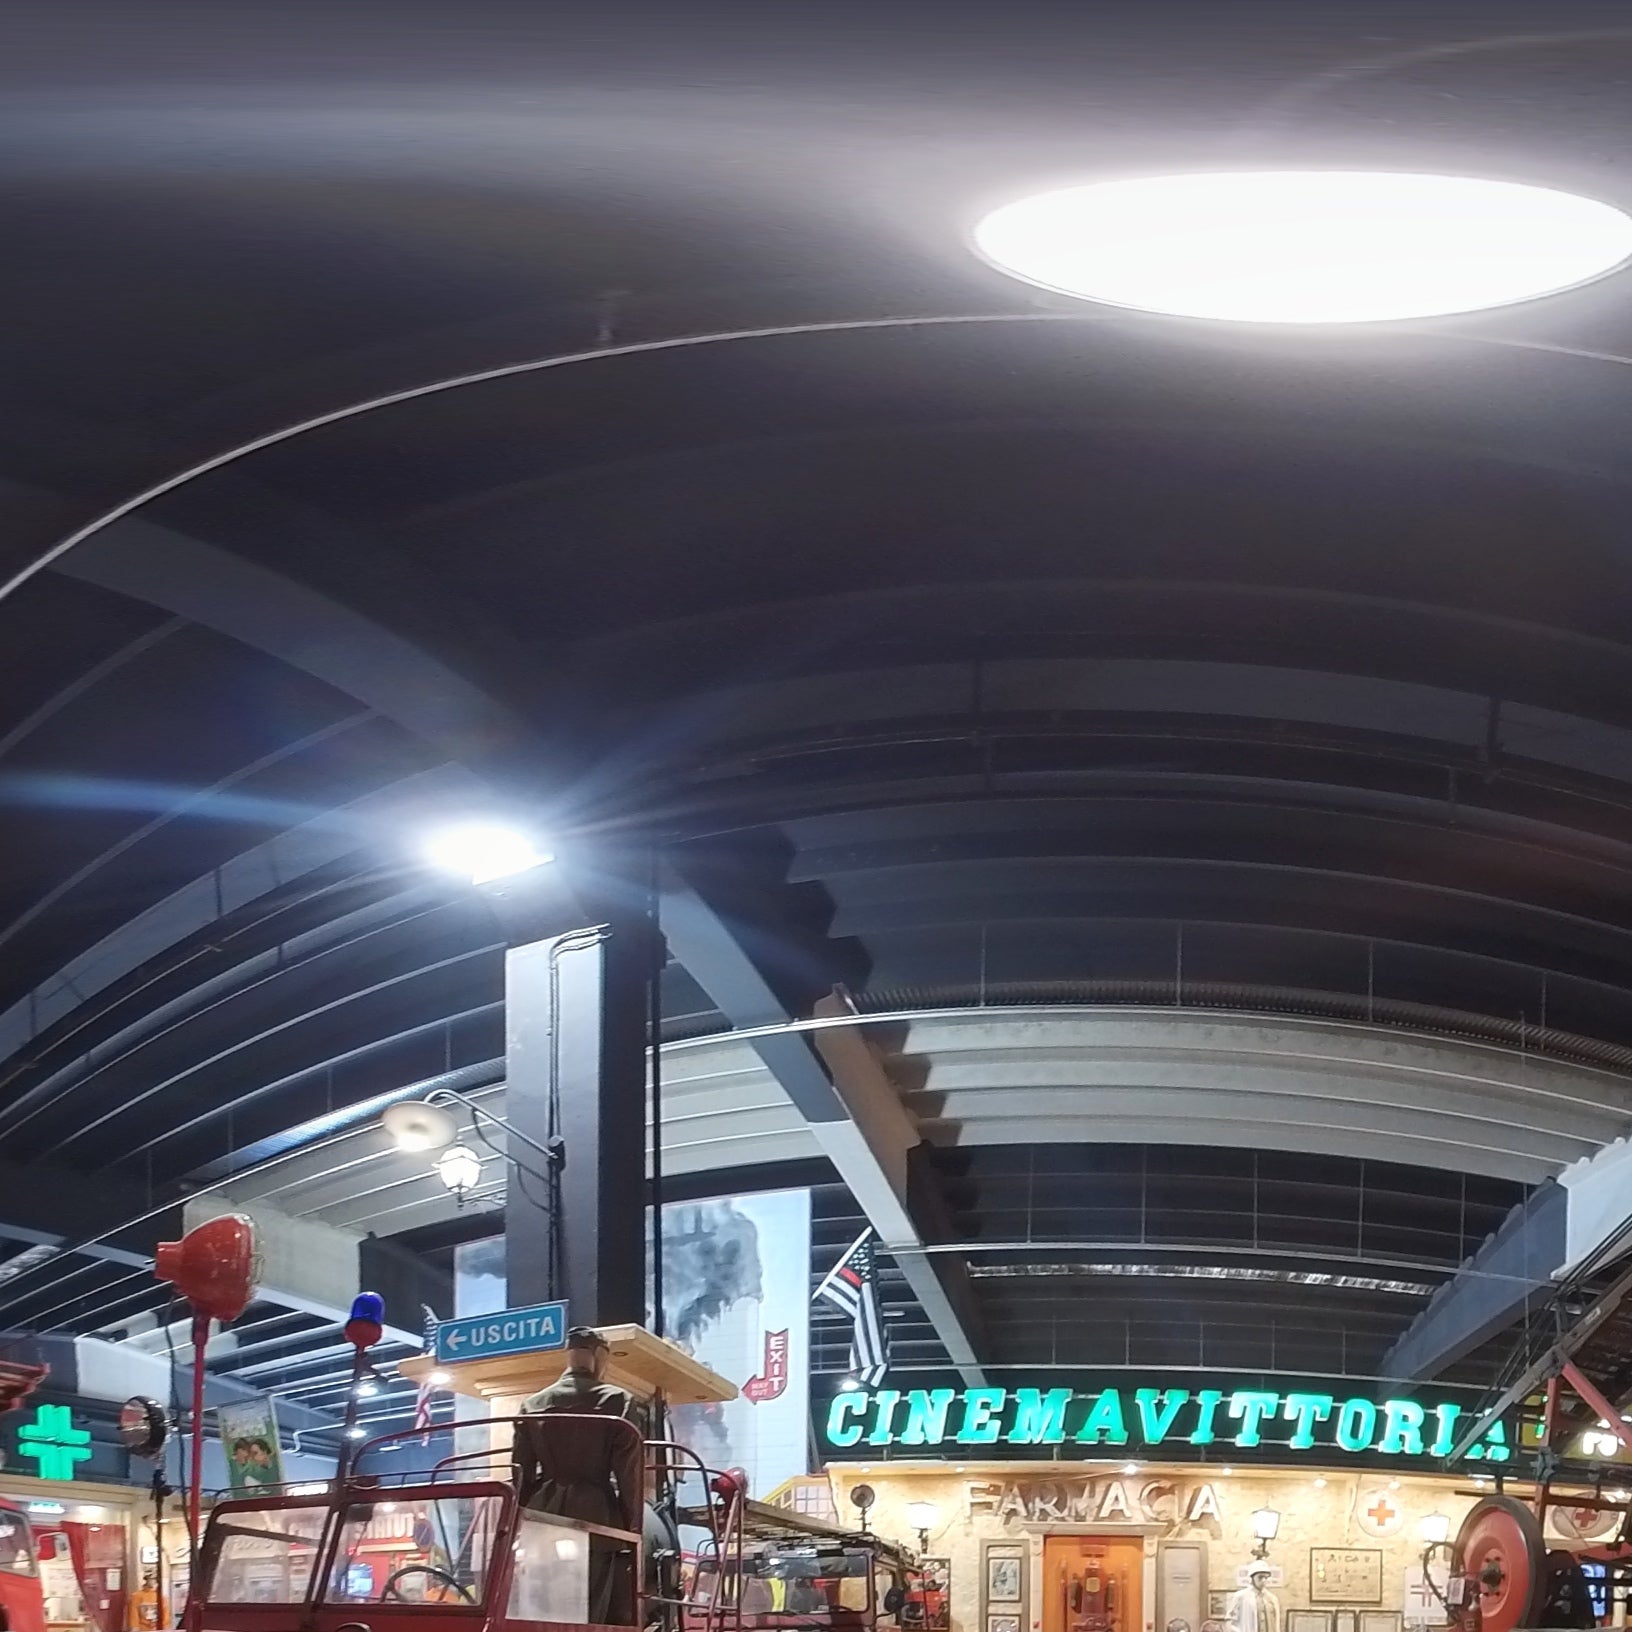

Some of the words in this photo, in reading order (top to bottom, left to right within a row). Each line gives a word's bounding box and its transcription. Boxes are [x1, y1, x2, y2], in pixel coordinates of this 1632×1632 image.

[470, 1316, 556, 1346] USCITA
[769, 1336, 785, 1391] EXIT
[962, 1479, 1222, 1523] FARMACIA
